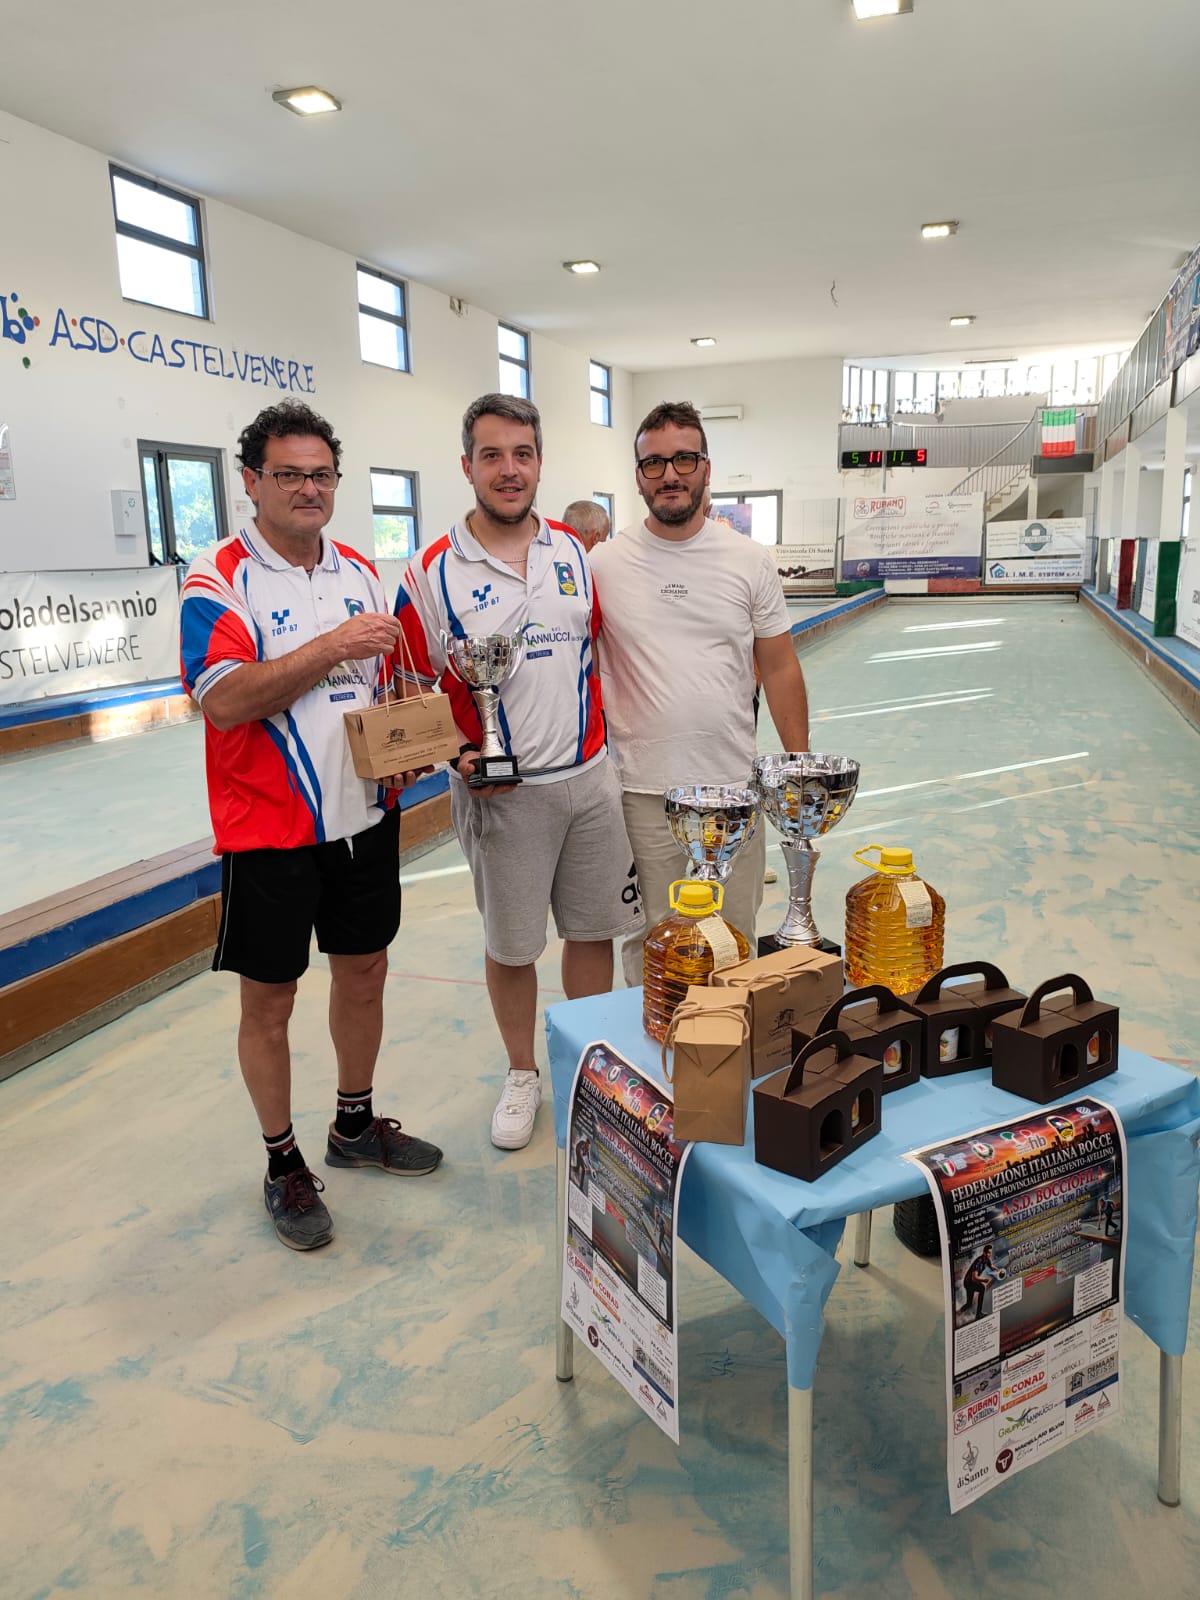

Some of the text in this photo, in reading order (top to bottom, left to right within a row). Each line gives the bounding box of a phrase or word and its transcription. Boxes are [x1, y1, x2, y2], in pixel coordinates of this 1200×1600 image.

[127, 330, 316, 393] CASTELVENERE
[917, 448, 926, 463] 5
[0, 590, 157, 631] oladelsannio
[474, 601, 489, 612] TOP
[272, 623, 298, 637] TOP 67
[0, 634, 143, 680] STELVENERE
[582, 1075, 621, 1119] FEDERAZIONE
[620, 1111, 651, 1146] ITALIANA
[651, 1138, 675, 1168] BOCCE
[951, 1132, 1113, 1203] FEDERAZIONE ITALIANA BOCCE
[954, 1189, 1000, 1213] DELEGAZIONE
[1000, 1173, 1041, 1196] PROVINCIALE
[1050, 1146, 1115, 1177] BENEVENTO-AVELLINO
[1003, 1193, 1034, 1215] A.S.D.
[1034, 1165, 1104, 1204] BOCCIOFILA
[1003, 1197, 1059, 1226] CASTELVENERE
[599, 1282, 619, 1310] CONAD
[1011, 1371, 1045, 1393] CONAD
[968, 1395, 998, 1422] RUBANO
